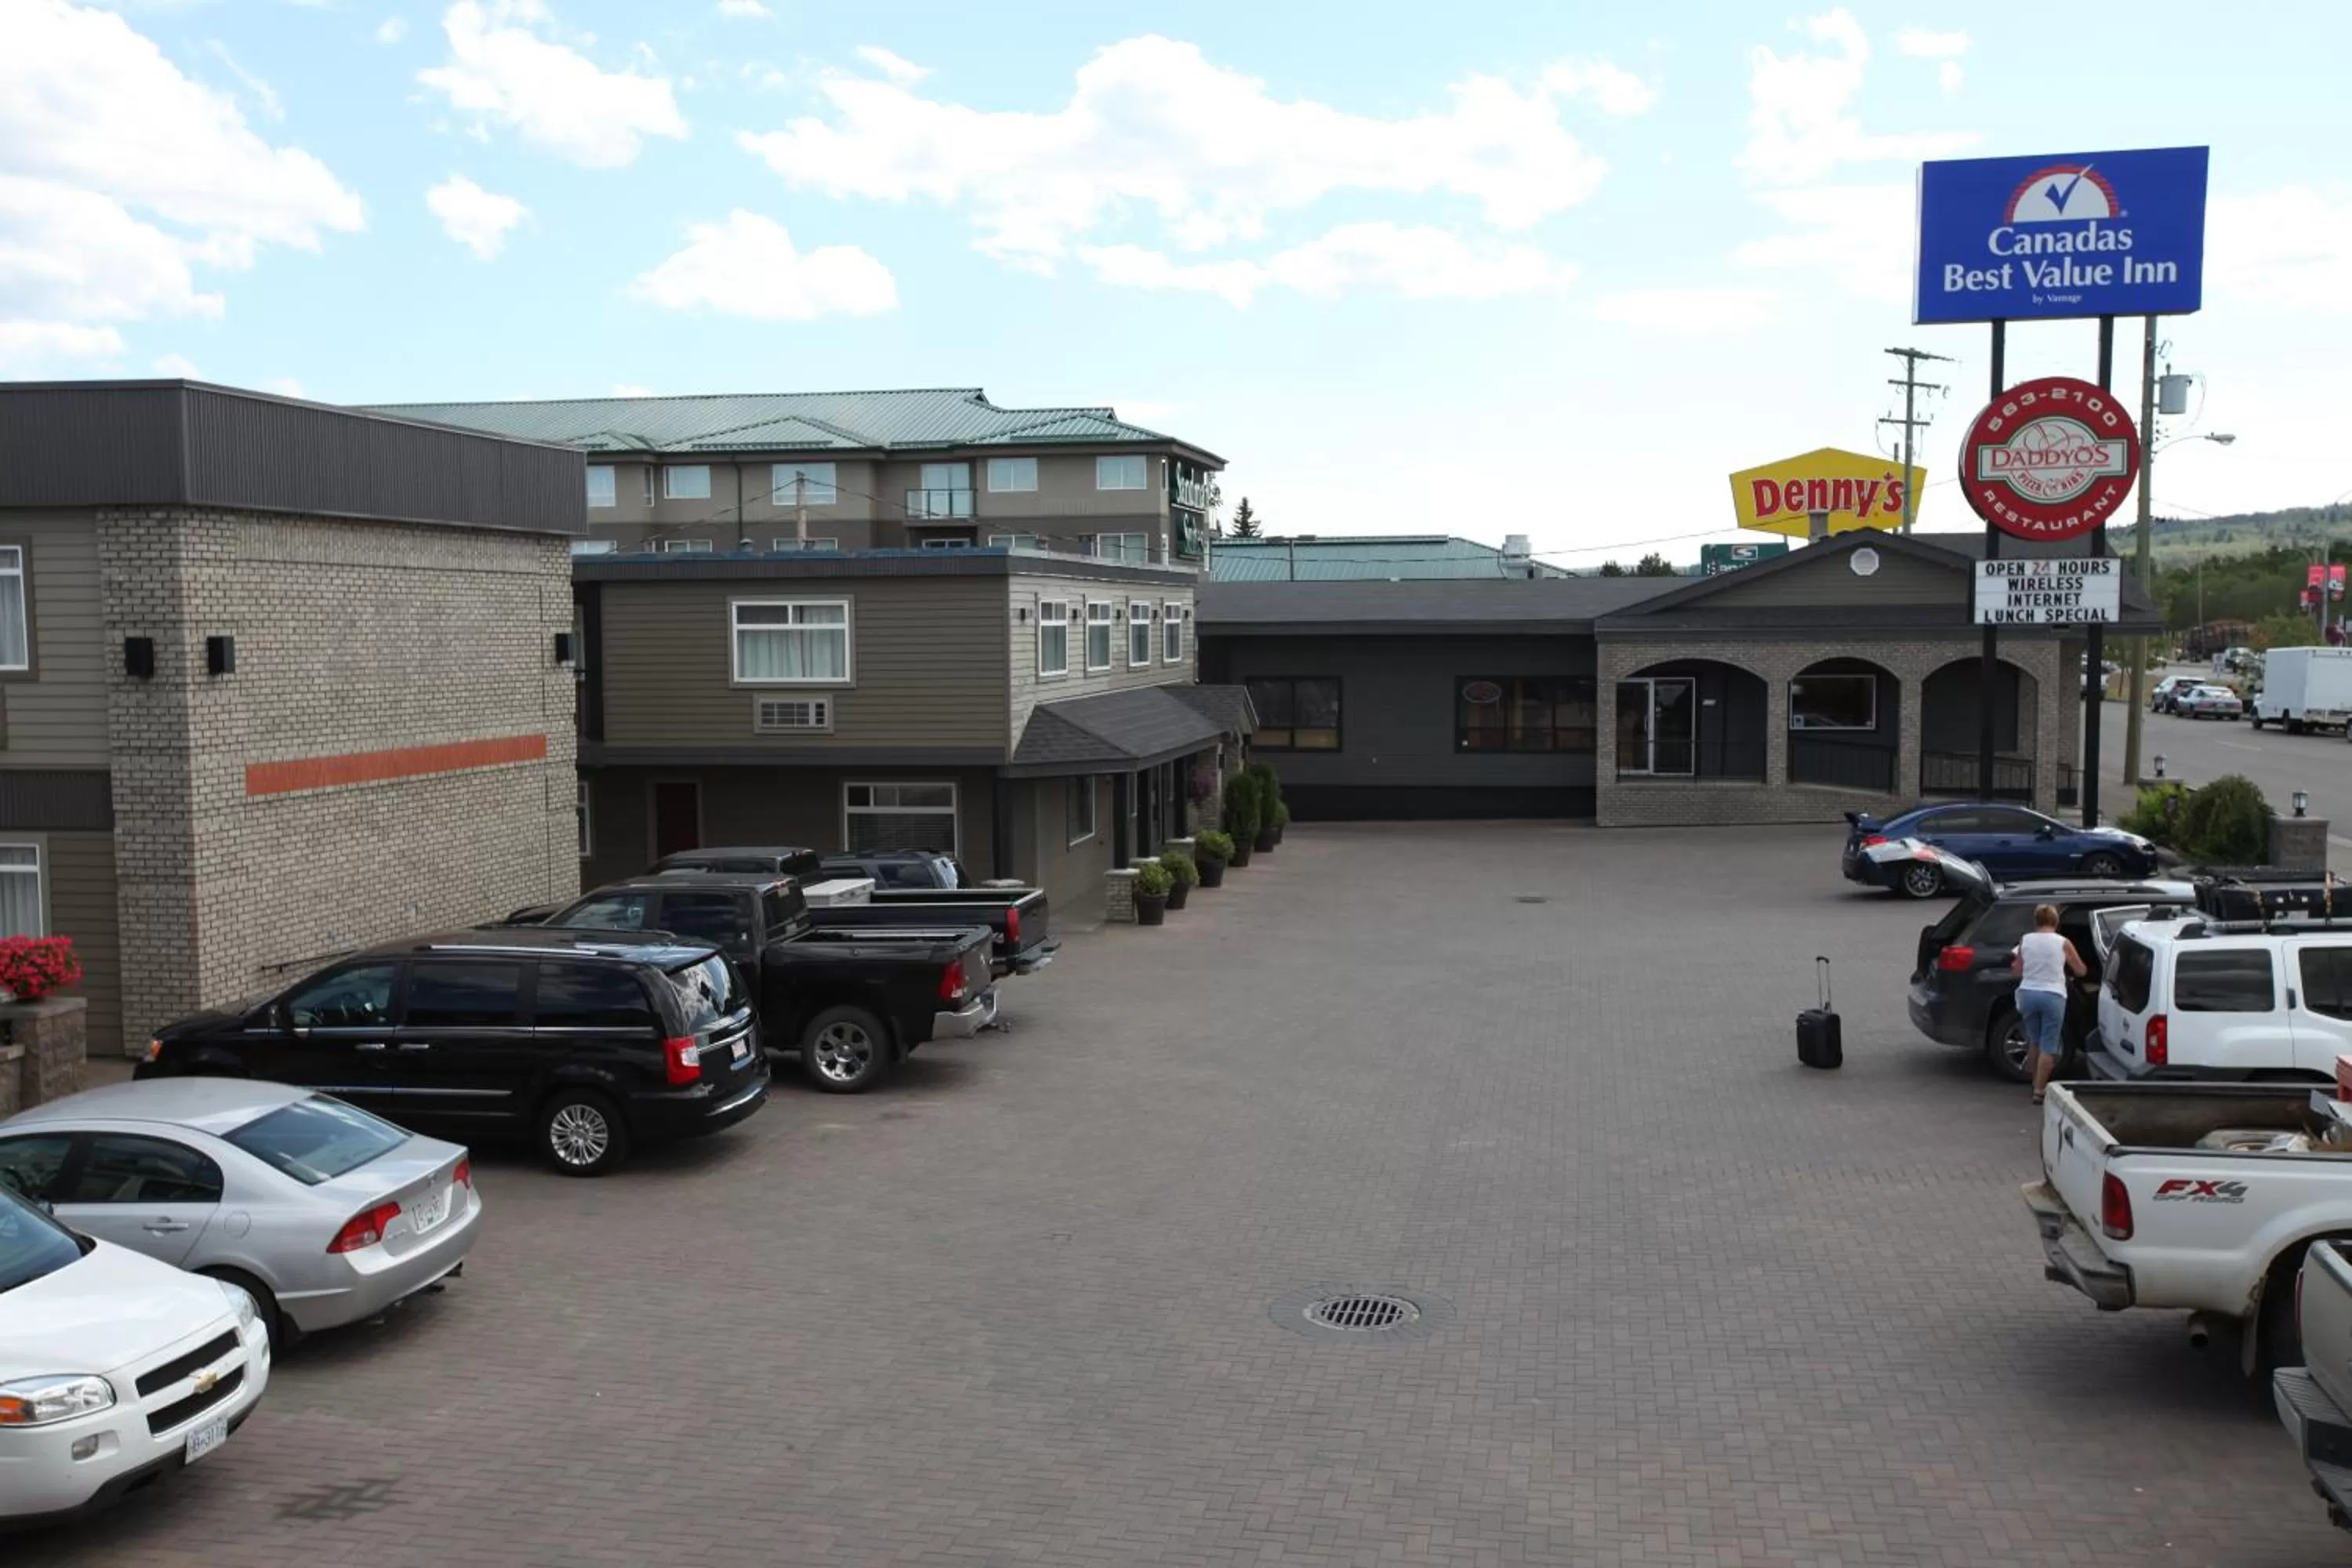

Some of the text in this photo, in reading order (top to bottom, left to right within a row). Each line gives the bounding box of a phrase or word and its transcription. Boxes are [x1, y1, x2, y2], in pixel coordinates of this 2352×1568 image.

[1988, 220, 2133, 256] Canadas
[1944, 256, 2177, 292] Best Value Inn
[1752, 470, 1904, 518] Denny's
[1984, 485, 2117, 531] RESTAURANT
[1986, 562, 2025, 575] OPEN
[2058, 561, 2110, 574] HOURS
[2008, 577, 2083, 590] WIRELESS
[2008, 593, 2082, 606] INTERNET
[1984, 608, 2109, 623] LUNCH SPECIAL
[2157, 1179, 2249, 1196] FX4
